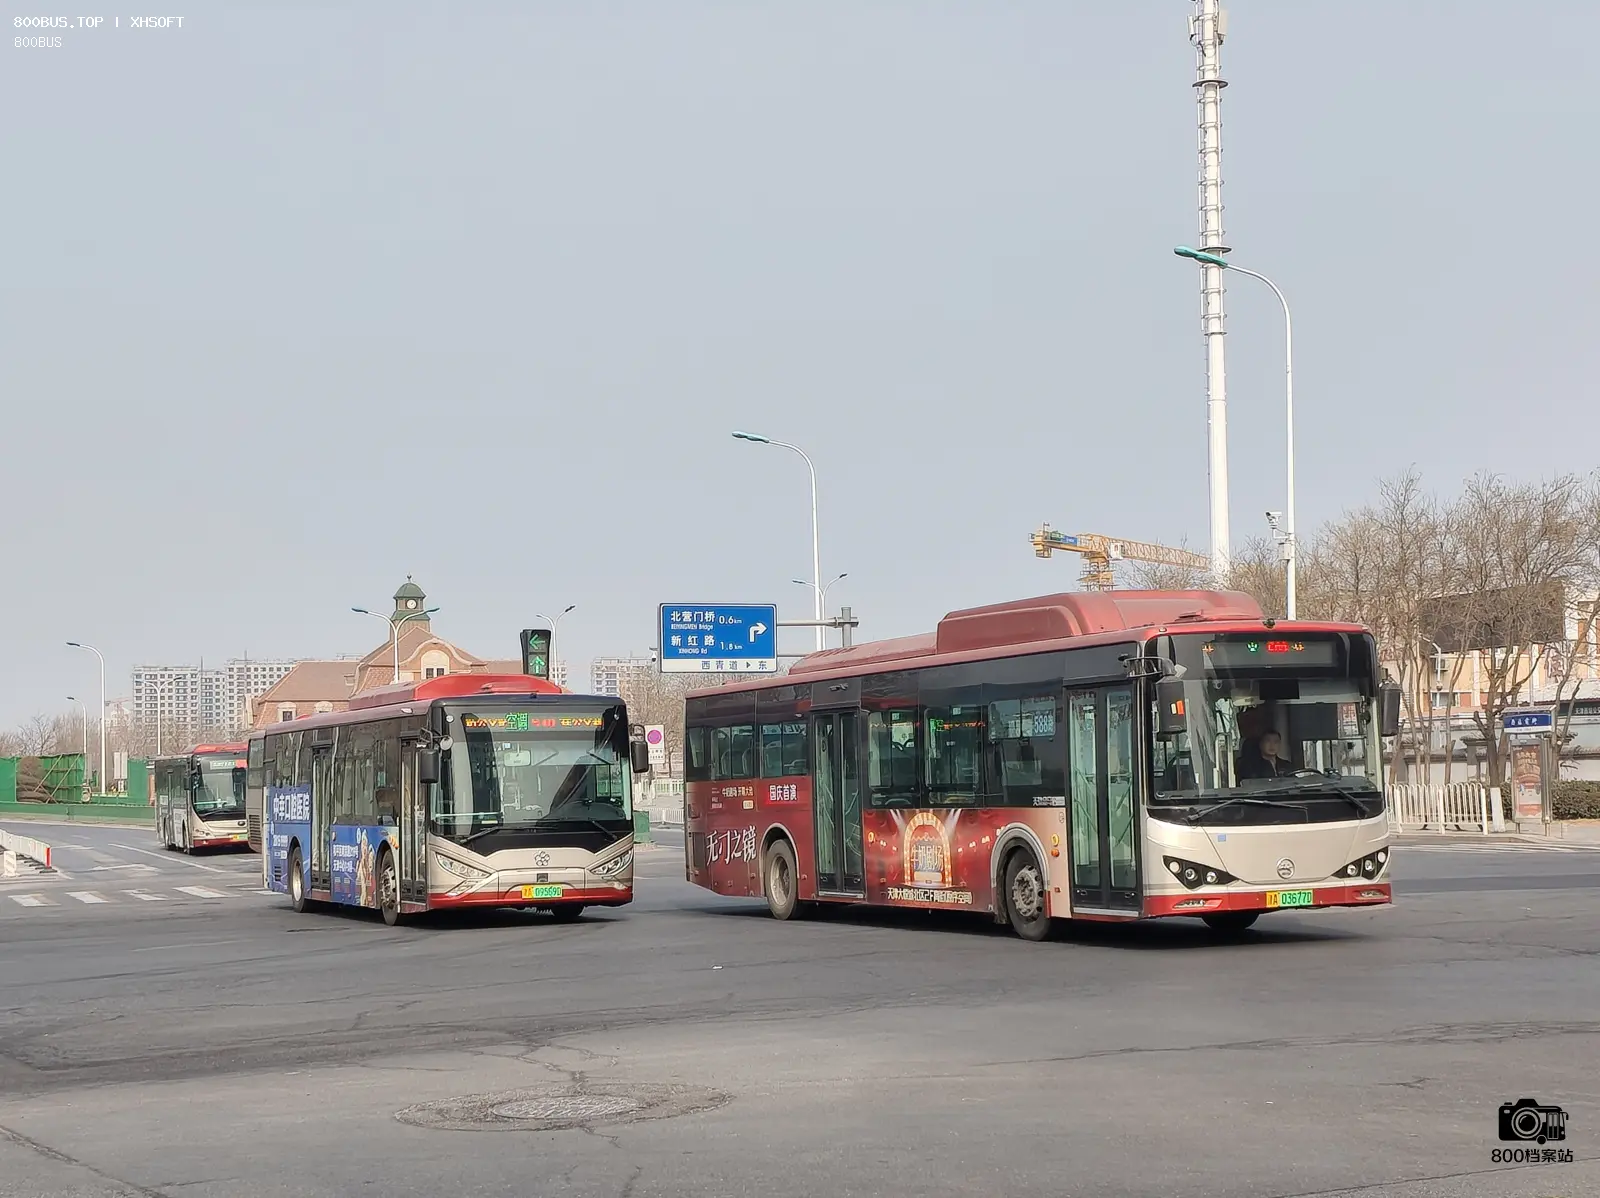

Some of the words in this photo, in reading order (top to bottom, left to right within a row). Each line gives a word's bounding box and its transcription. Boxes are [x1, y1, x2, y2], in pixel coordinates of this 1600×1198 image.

[670, 611, 715, 622] 北营门桥
[670, 635, 715, 647] 新红路
[701, 660, 737, 670] 西青道
[769, 784, 797, 801] 国庆首演
